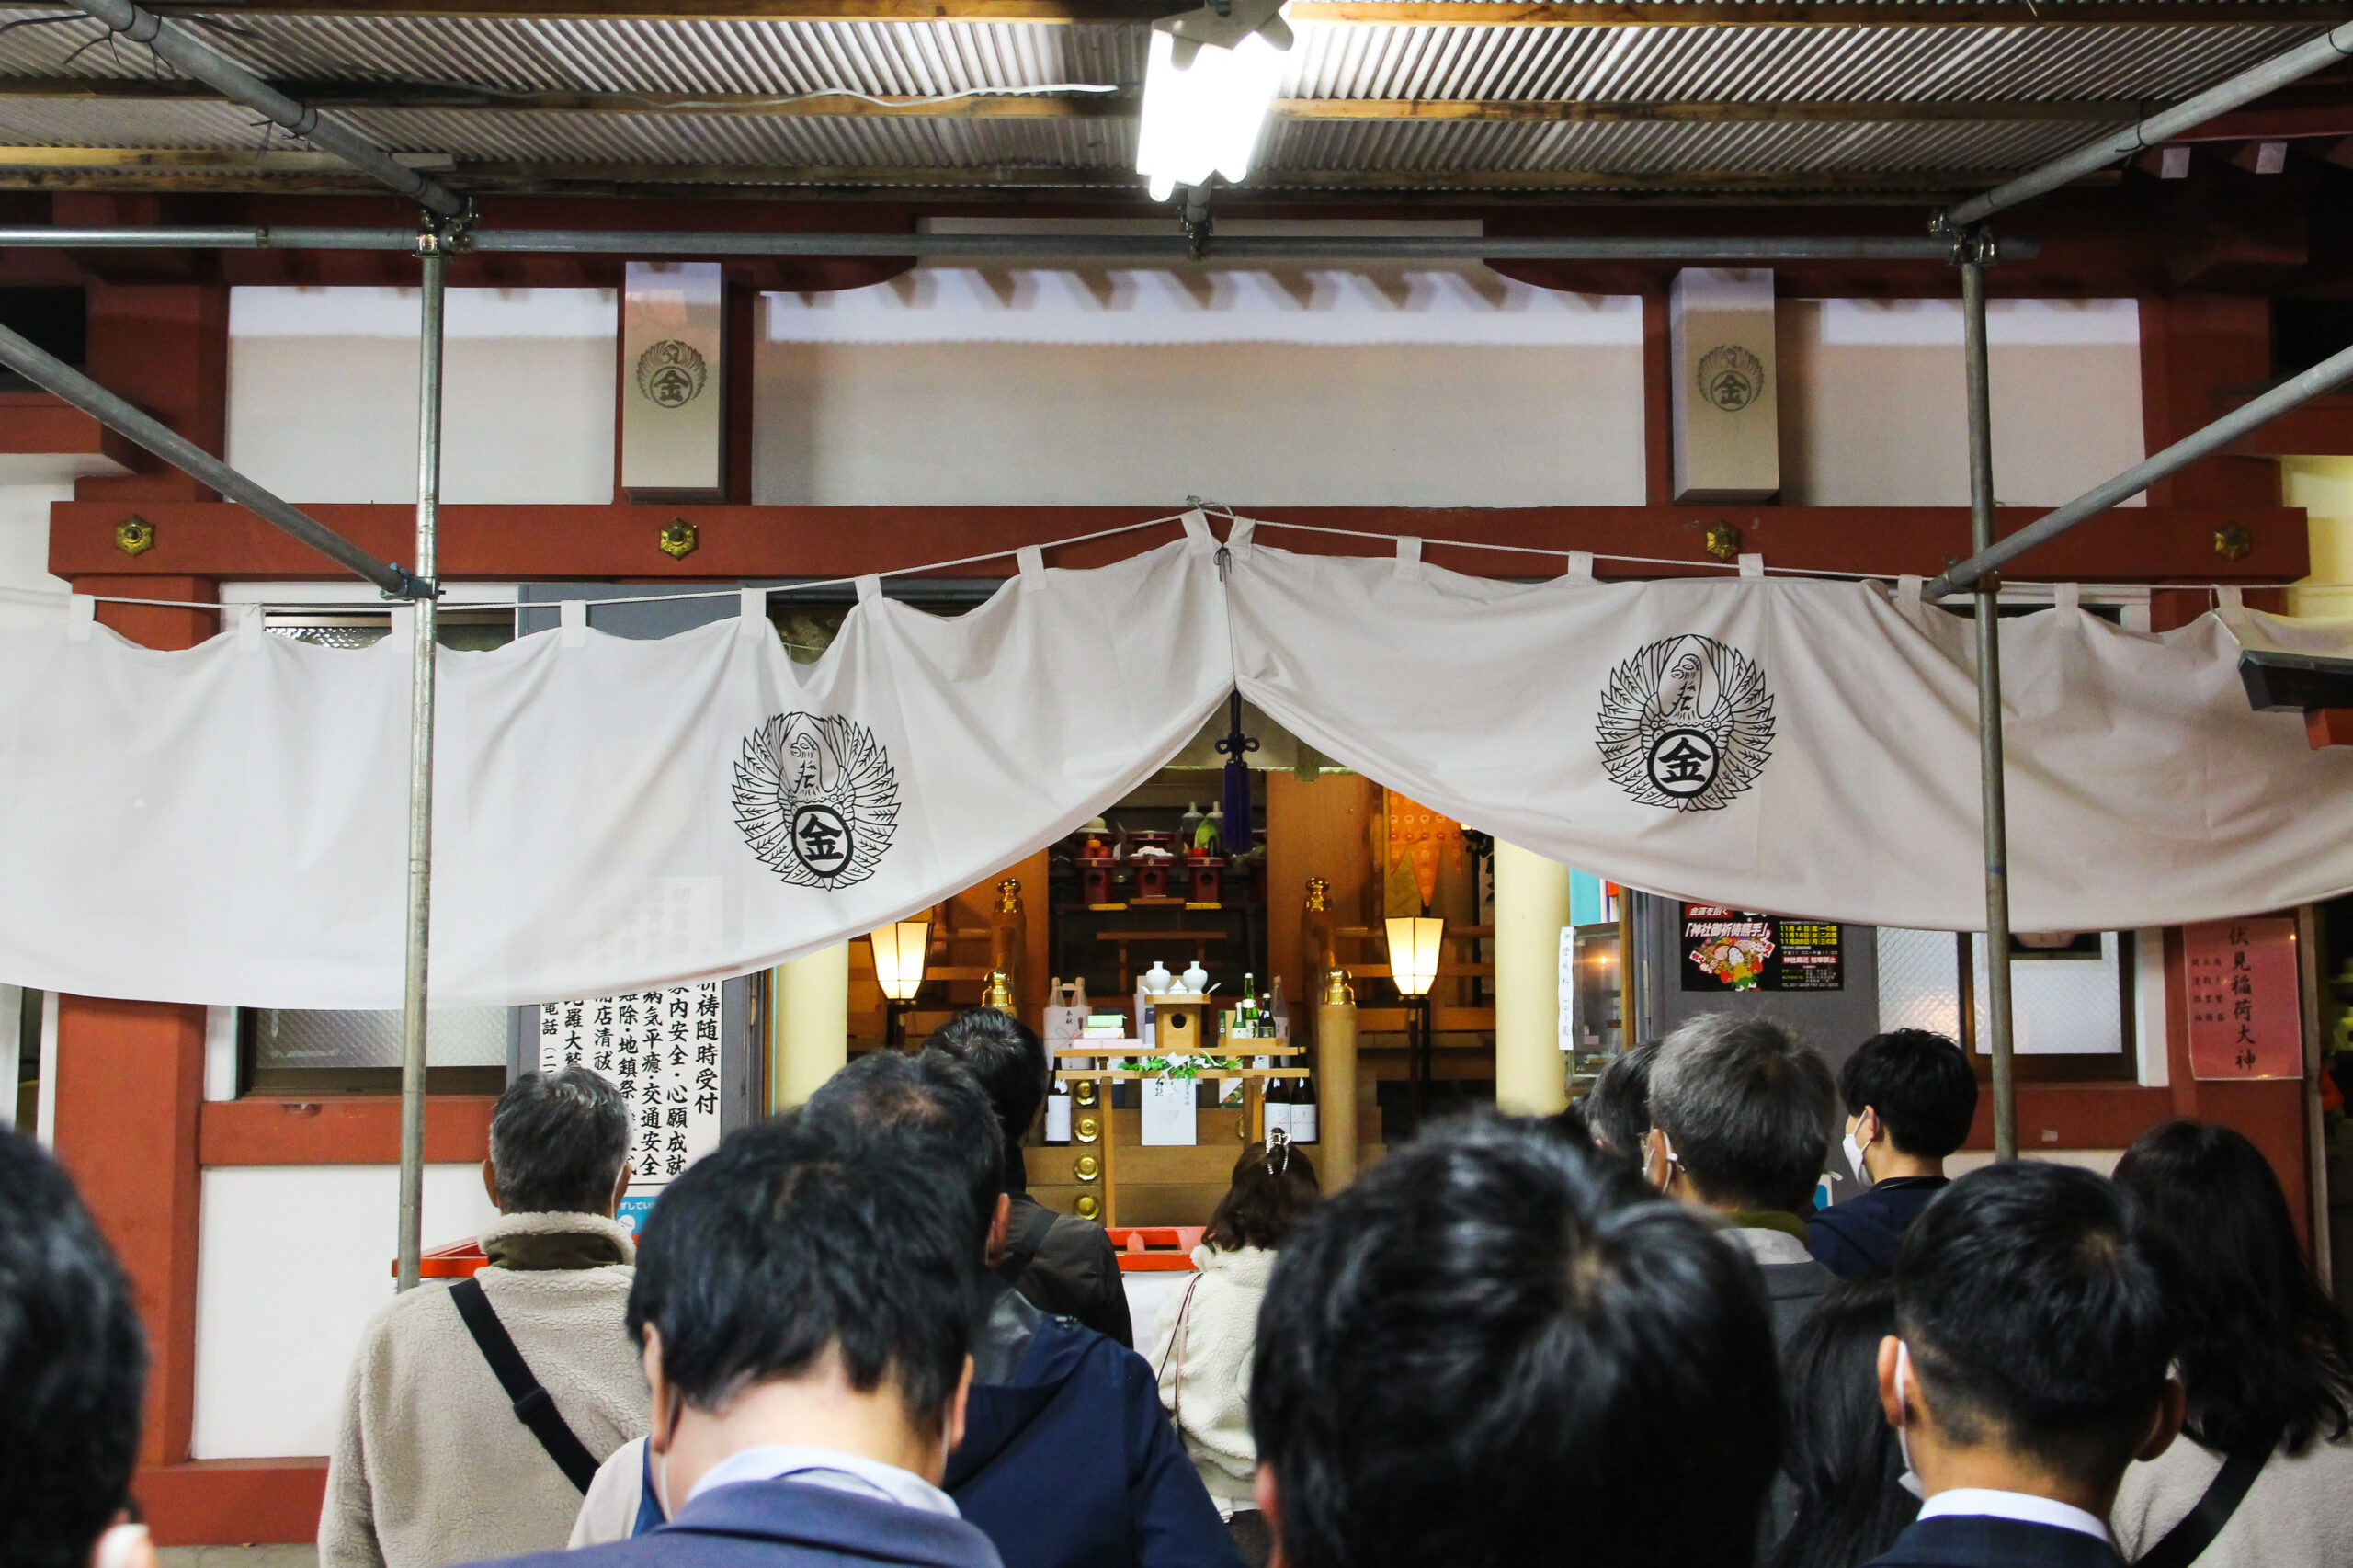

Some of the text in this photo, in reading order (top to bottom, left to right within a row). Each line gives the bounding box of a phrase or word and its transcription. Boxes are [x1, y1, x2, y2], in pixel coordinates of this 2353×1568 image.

[654, 370, 688, 402] 金
[1714, 374, 1747, 404] 金
[1658, 737, 1711, 783] 金
[799, 814, 844, 861] 金
[2229, 926, 2256, 1071] 伏見稲荷大神
